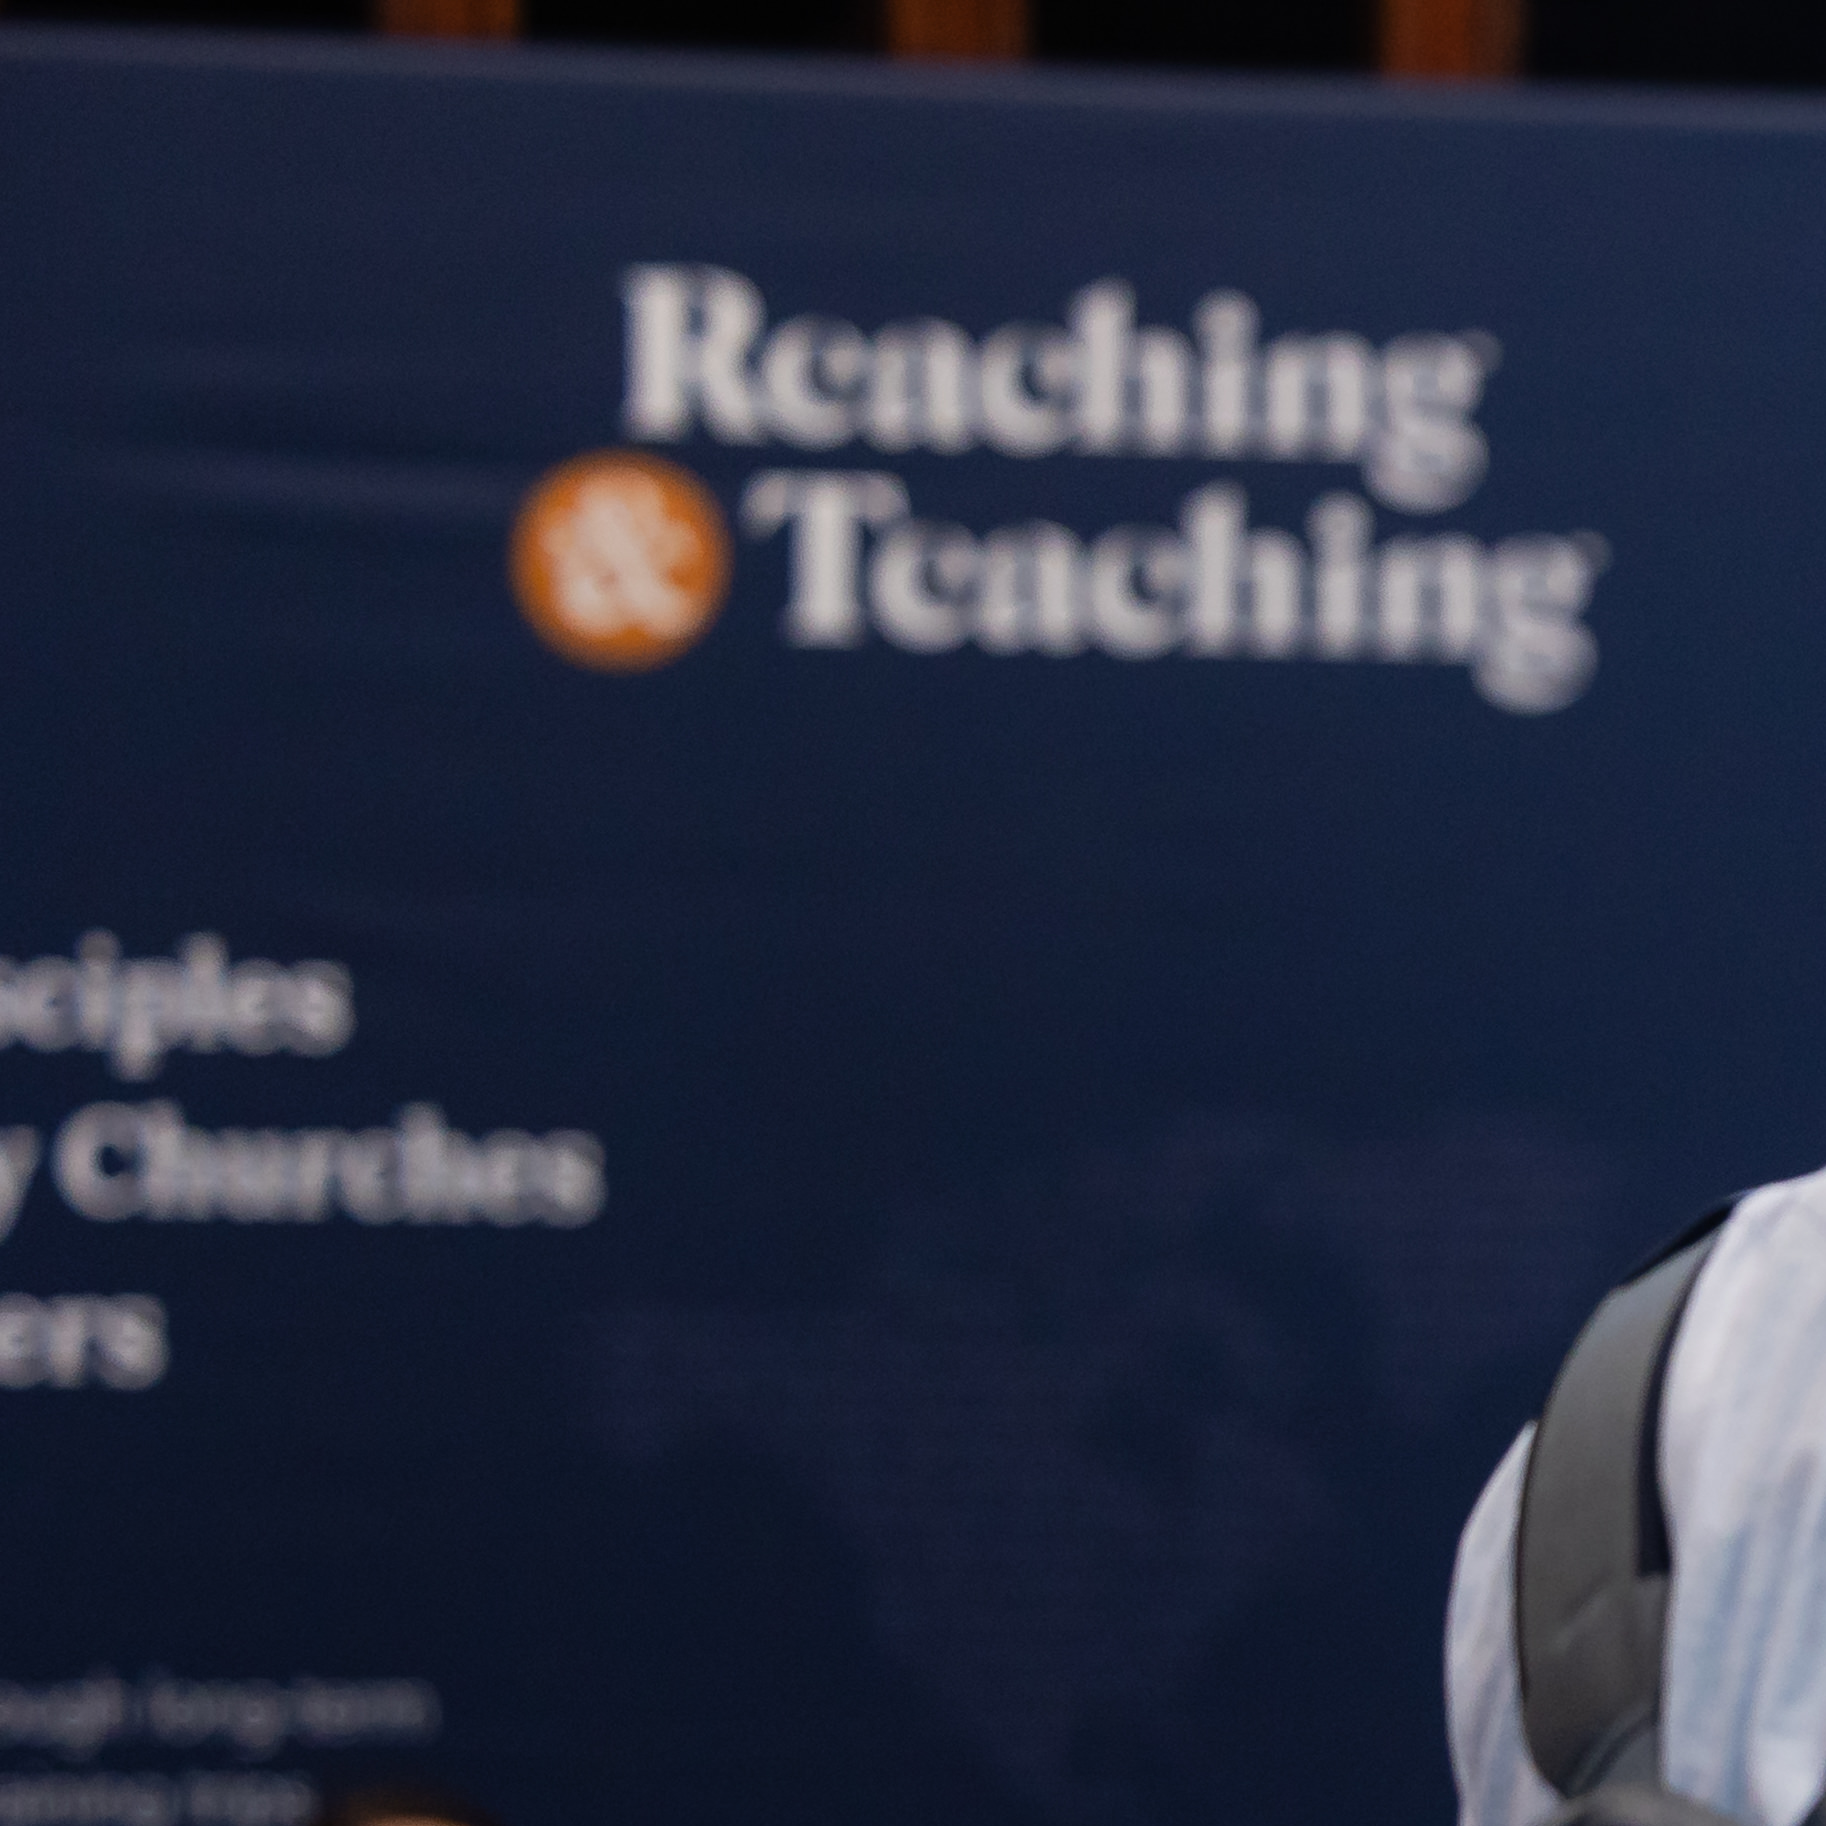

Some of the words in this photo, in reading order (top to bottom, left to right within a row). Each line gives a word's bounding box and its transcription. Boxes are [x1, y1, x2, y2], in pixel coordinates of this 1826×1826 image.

[622, 264, 1488, 512] Reaching
[543, 466, 704, 644] &
[742, 470, 1597, 715] Teaching
[54, 1102, 606, 1228] Churches
